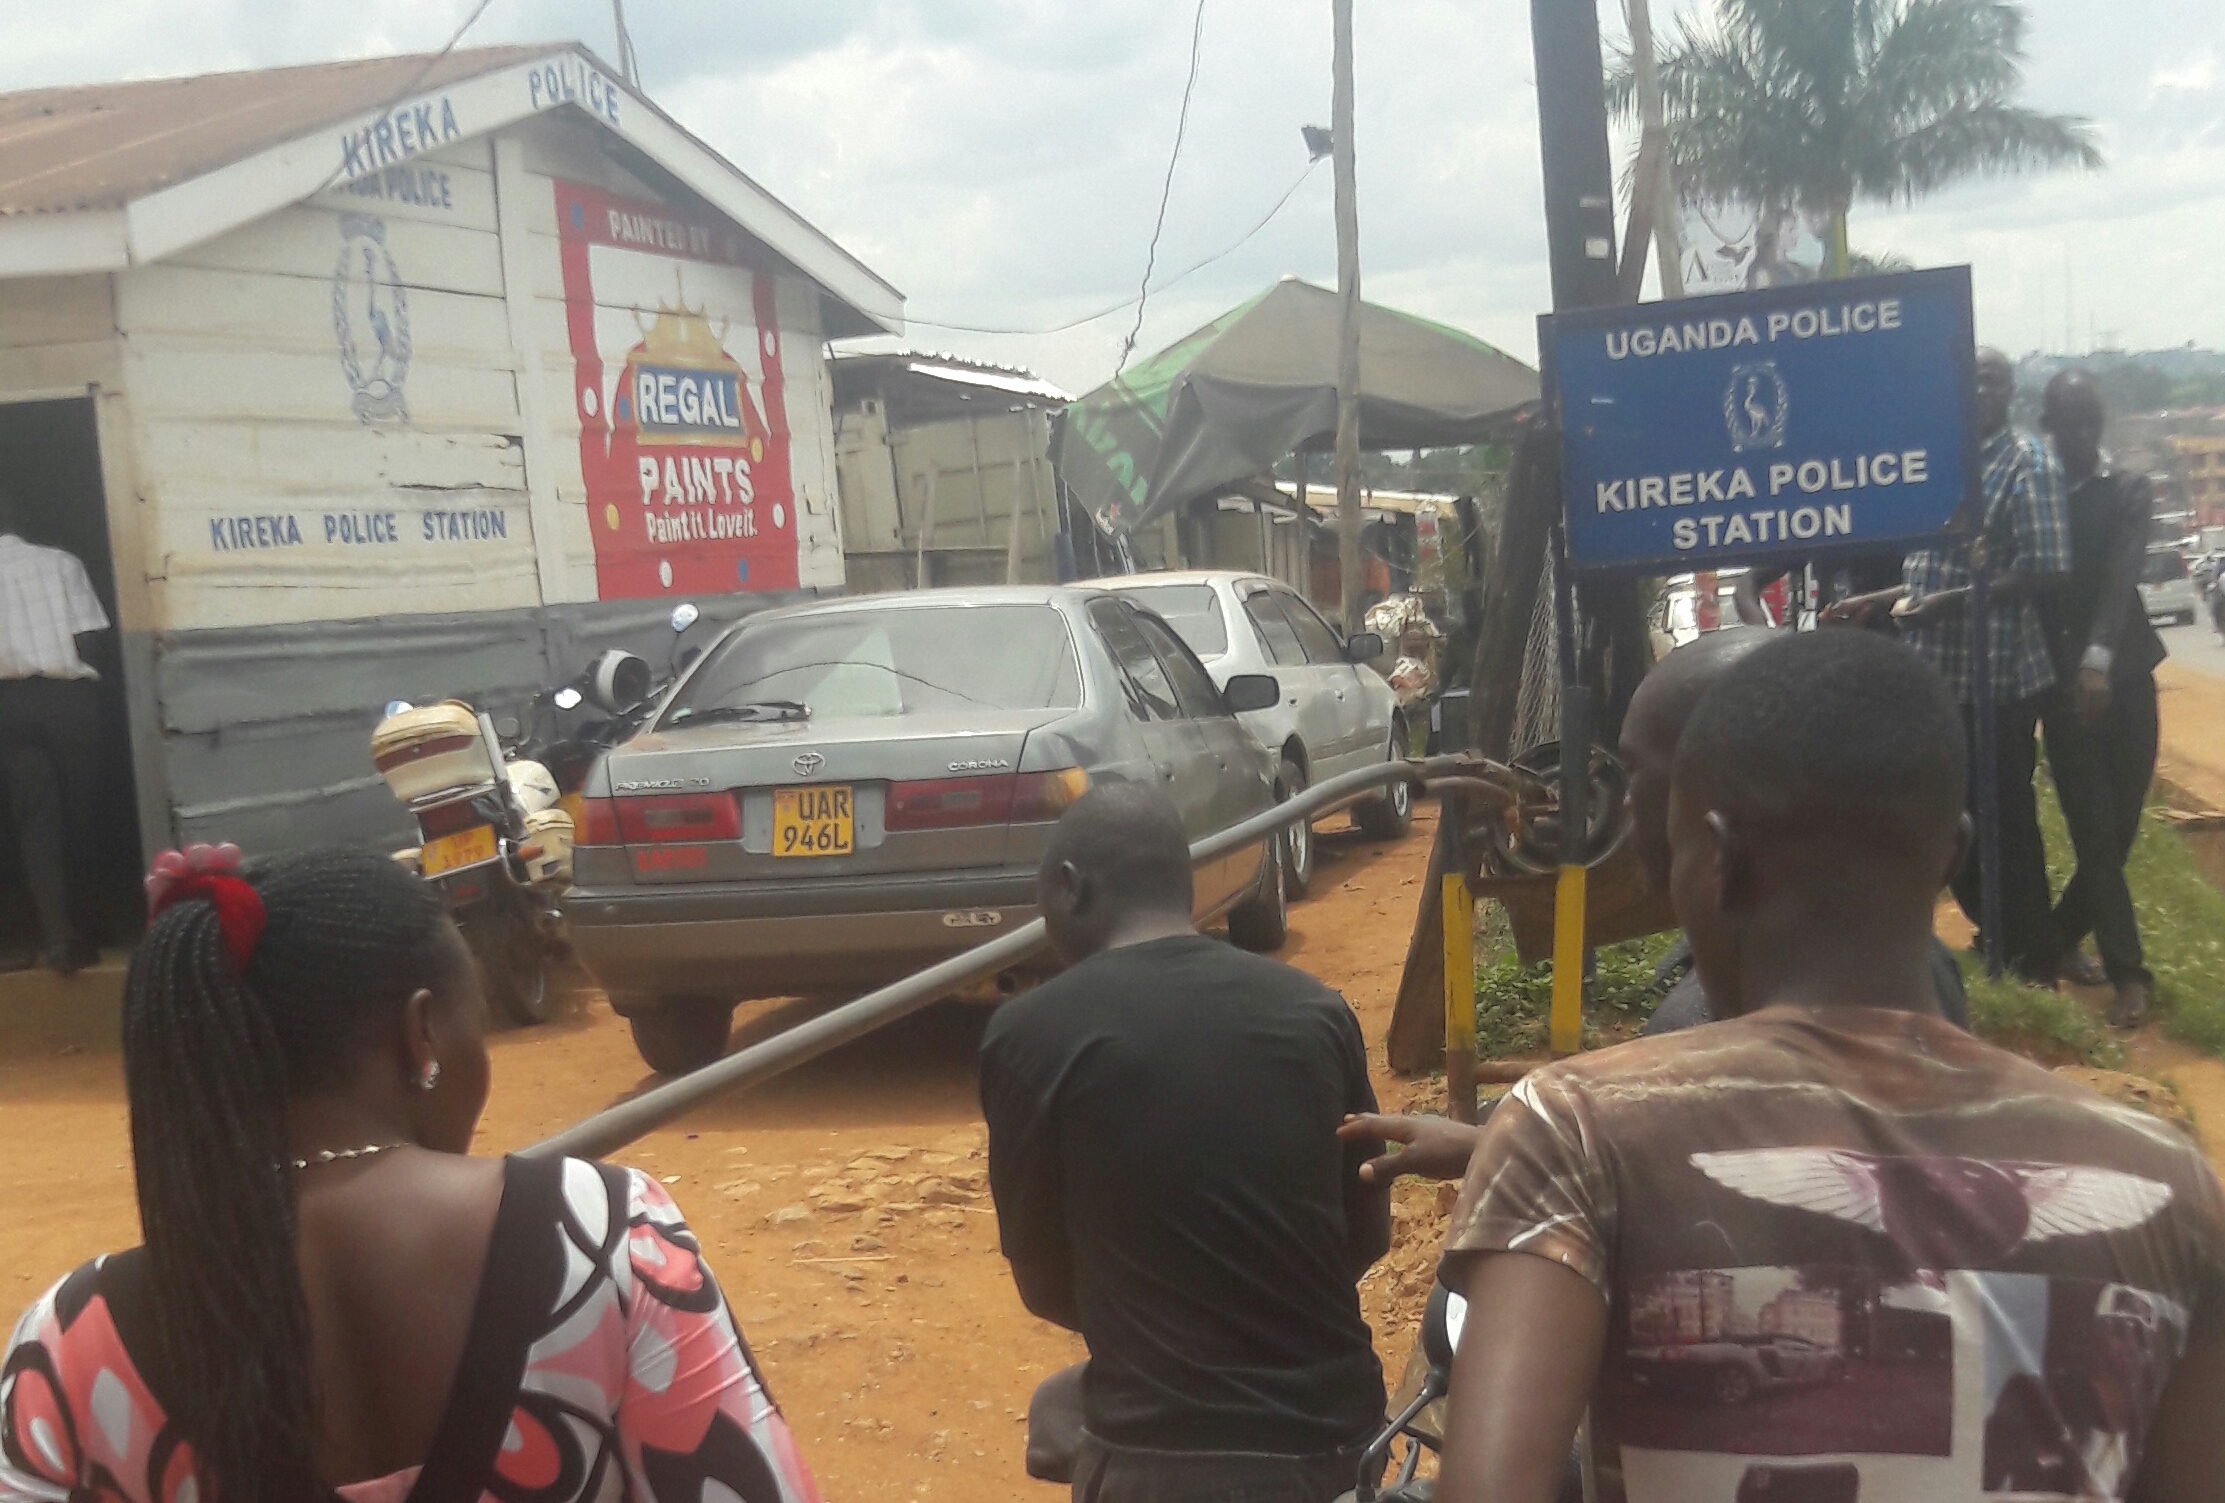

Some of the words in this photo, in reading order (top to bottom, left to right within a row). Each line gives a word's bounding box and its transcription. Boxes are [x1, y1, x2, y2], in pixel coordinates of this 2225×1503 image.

[341, 97, 461, 178] KIREKA
[527, 63, 619, 125] POLICE
[1605, 316, 1760, 361] UGANDA
[1767, 300, 1902, 343] POLICE
[638, 374, 741, 428] REGAL
[638, 456, 756, 506] PAINTS
[1596, 467, 1756, 514] KIREKA
[1768, 449, 1930, 496] POLICE
[209, 514, 303, 552] KIREKA
[323, 511, 399, 545] POLICE
[422, 509, 508, 543] STATION
[644, 510, 692, 544] Paint
[708, 508, 743, 539] Love
[1671, 504, 1852, 551] STATION
[947, 758, 1009, 773] CORONA
[799, 790, 850, 821] UAR
[783, 822, 850, 853] 946L
